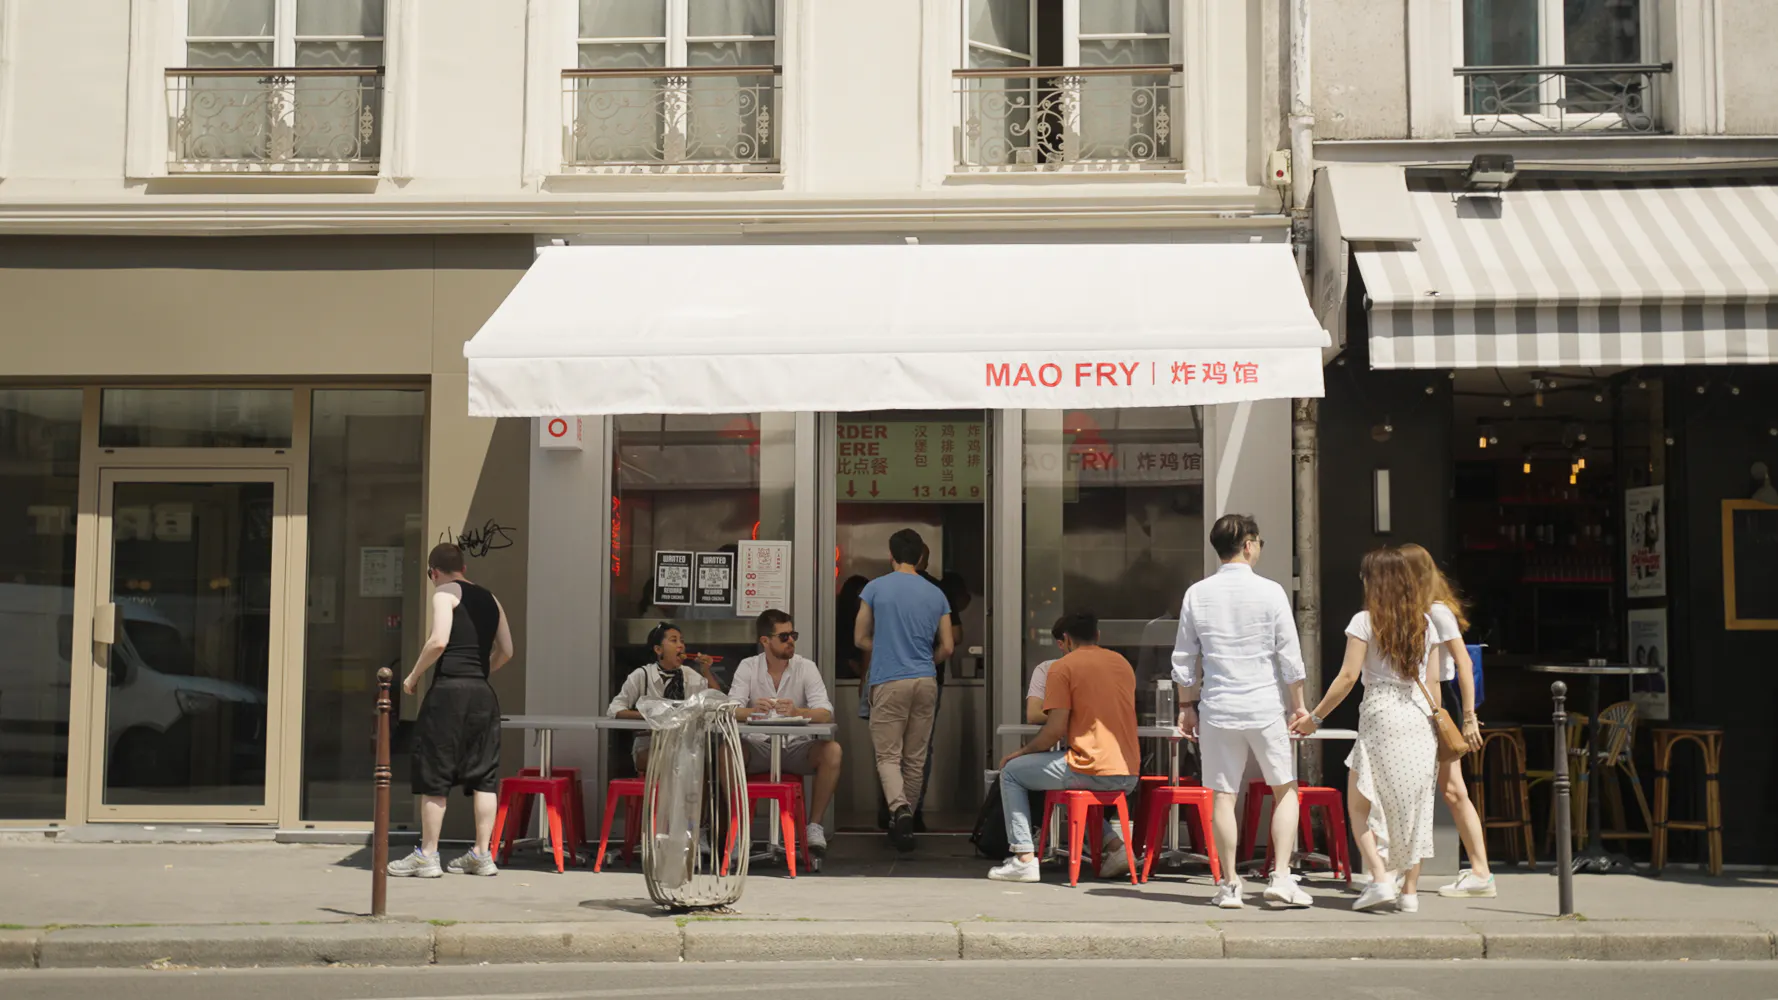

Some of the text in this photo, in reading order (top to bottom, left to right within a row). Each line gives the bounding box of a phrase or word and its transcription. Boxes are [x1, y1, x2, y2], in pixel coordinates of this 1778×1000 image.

[985, 361, 1140, 387] MAO FRY
[1171, 361, 1259, 385] 炸鸡馆
[837, 425, 888, 439] RDER
[839, 442, 880, 456] ERE
[914, 425, 928, 468] 汉堡包
[941, 424, 955, 482] 鸡排便当
[967, 424, 981, 468] 炸鸡排
[837, 457, 889, 475] 此点餐
[1067, 452, 1114, 471] FRY
[1136, 451, 1202, 471] 炸鸡馆
[912, 485, 980, 497] 13 14 9
[702, 556, 727, 564] WANTED
